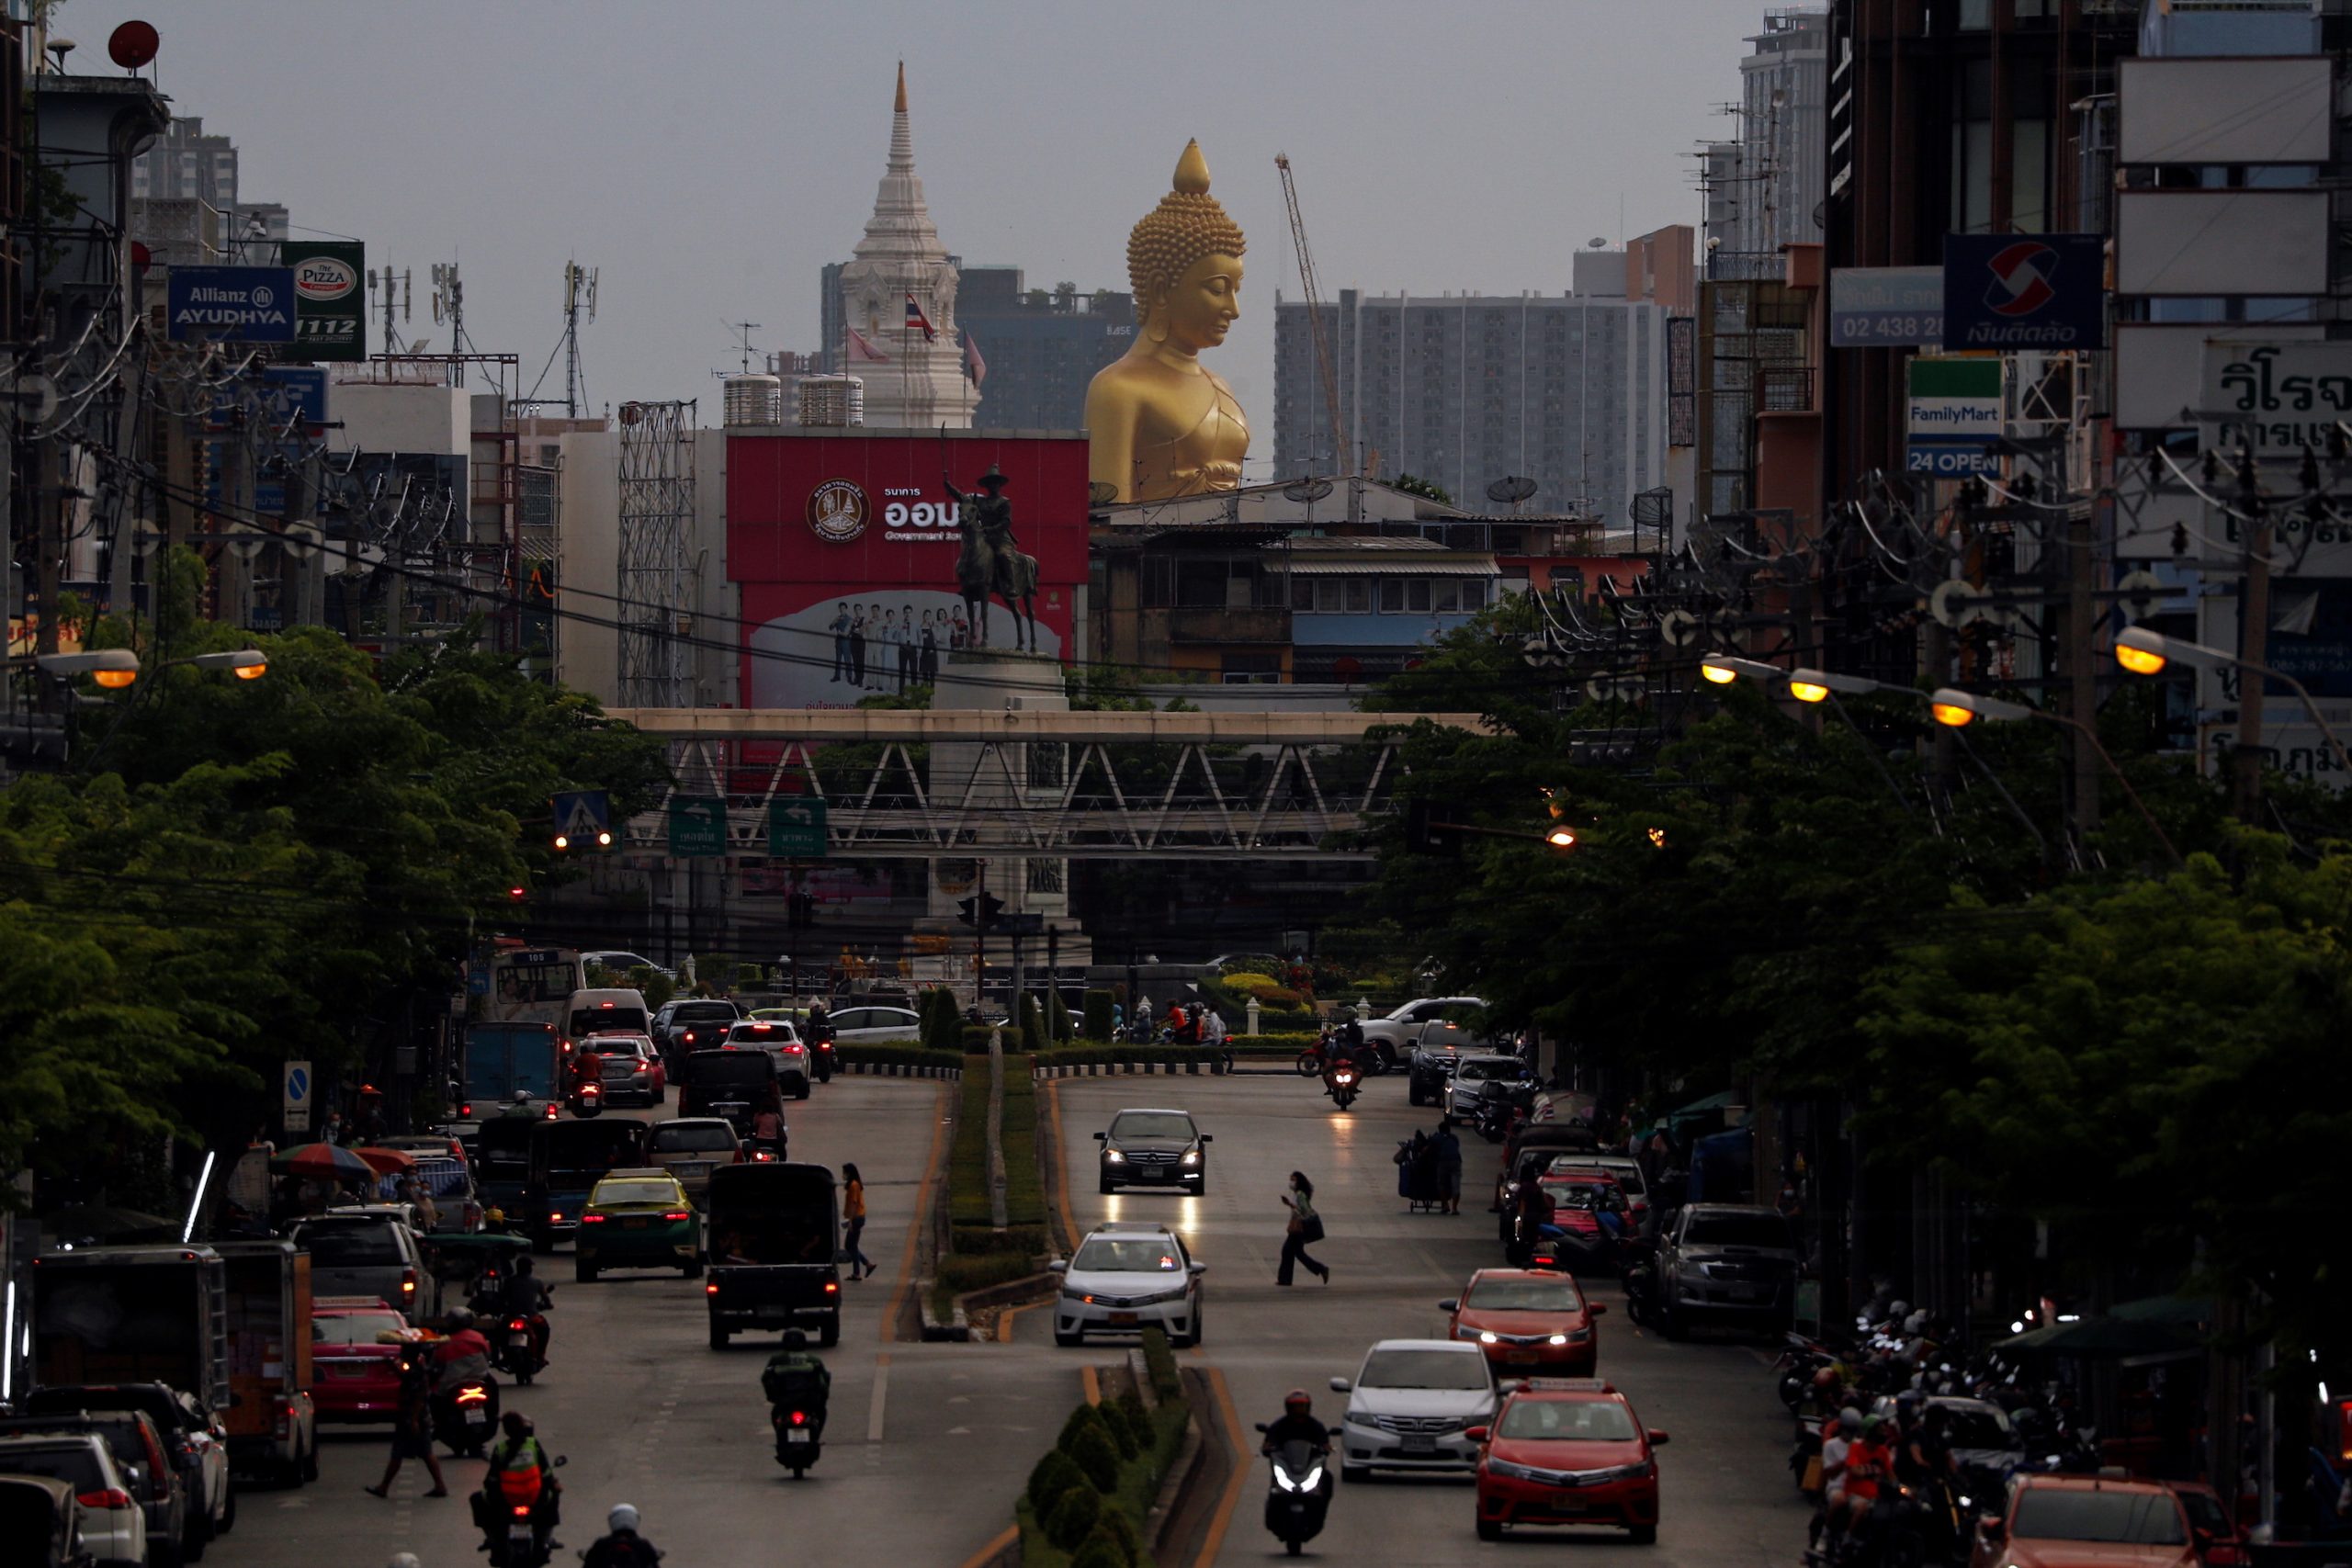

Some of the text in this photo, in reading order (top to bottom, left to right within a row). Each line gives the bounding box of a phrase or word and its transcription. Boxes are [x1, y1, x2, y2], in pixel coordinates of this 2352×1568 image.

[303, 269, 345, 283] PIZZA
[189, 287, 249, 303] Allianz
[175, 309, 288, 324] AYUDHYA
[1843, 318, 1870, 337] 02
[1875, 317, 1917, 337] 438
[1911, 407, 1998, 424] FamilyMart
[1910, 452, 1998, 472] 24 OPEN
[528, 953, 545, 962] 105
